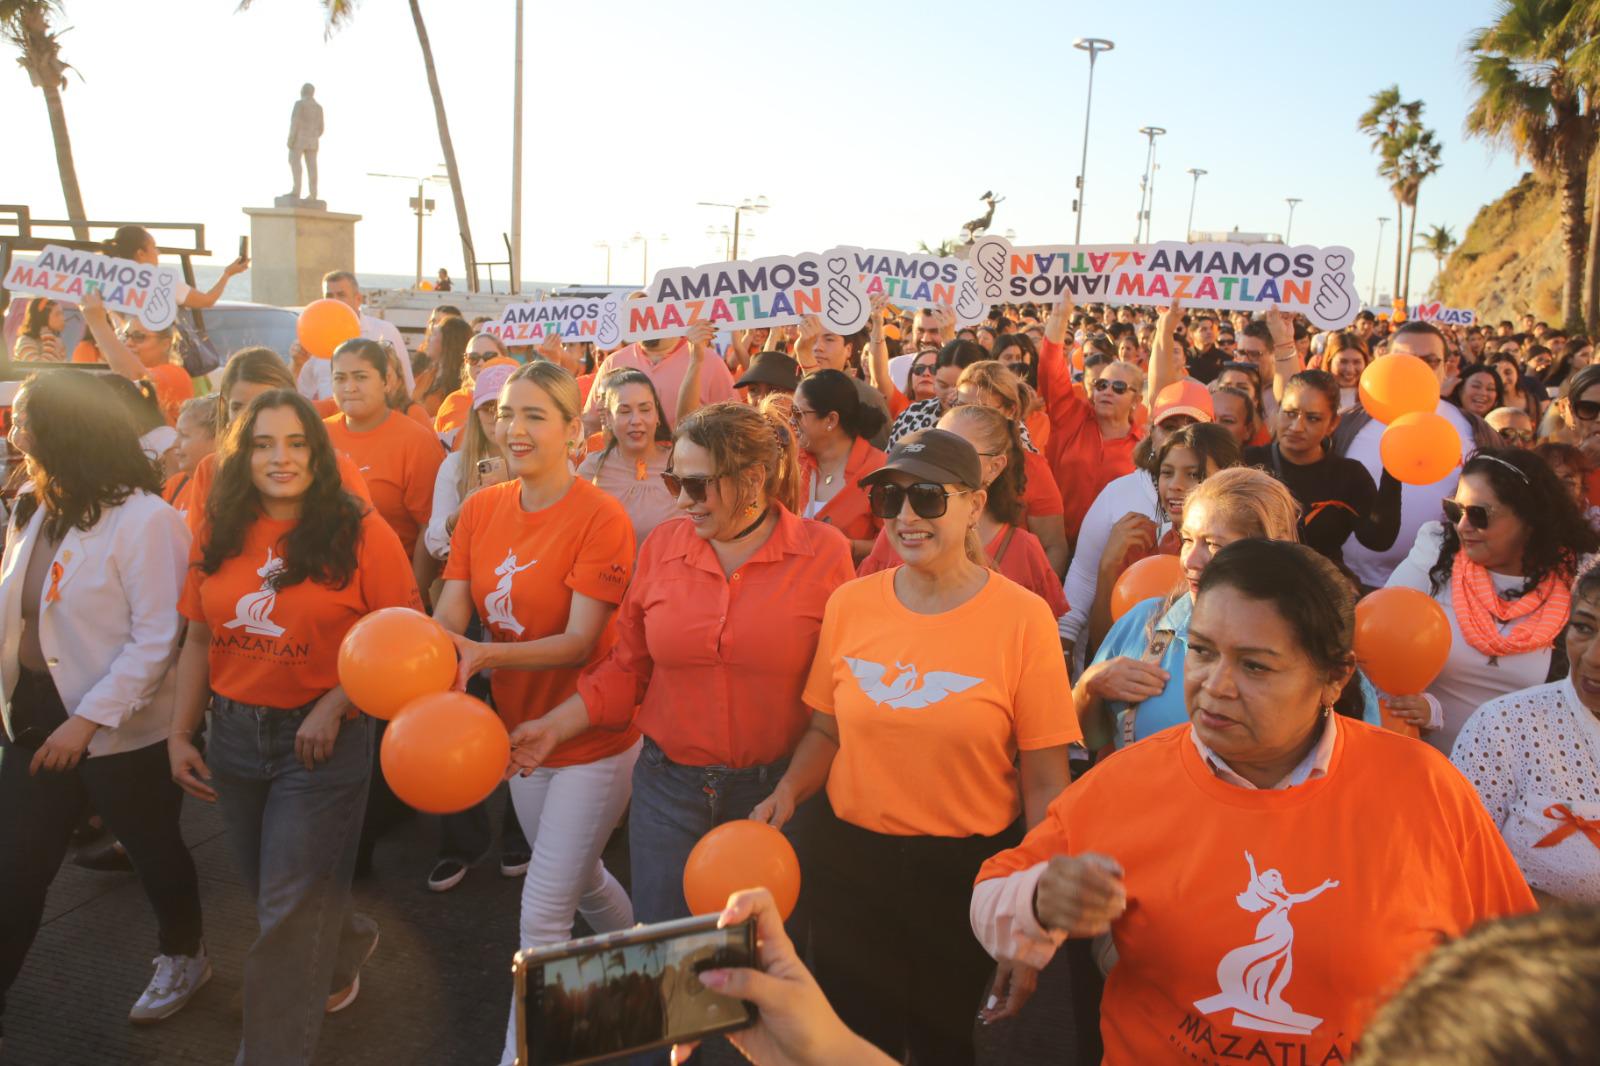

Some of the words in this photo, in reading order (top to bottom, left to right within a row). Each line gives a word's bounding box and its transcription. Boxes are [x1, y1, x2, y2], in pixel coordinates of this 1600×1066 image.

[38, 252, 152, 288] AMAMOS
[854, 253, 958, 283] MAMOS
[1147, 250, 1315, 278] AMAMOS
[657, 261, 820, 303] AMAMOS
[504, 303, 599, 324] AMAMOS
[210, 635, 309, 657] MAZATLÁN
[1178, 1013, 1358, 1066] MAZATLÁ
